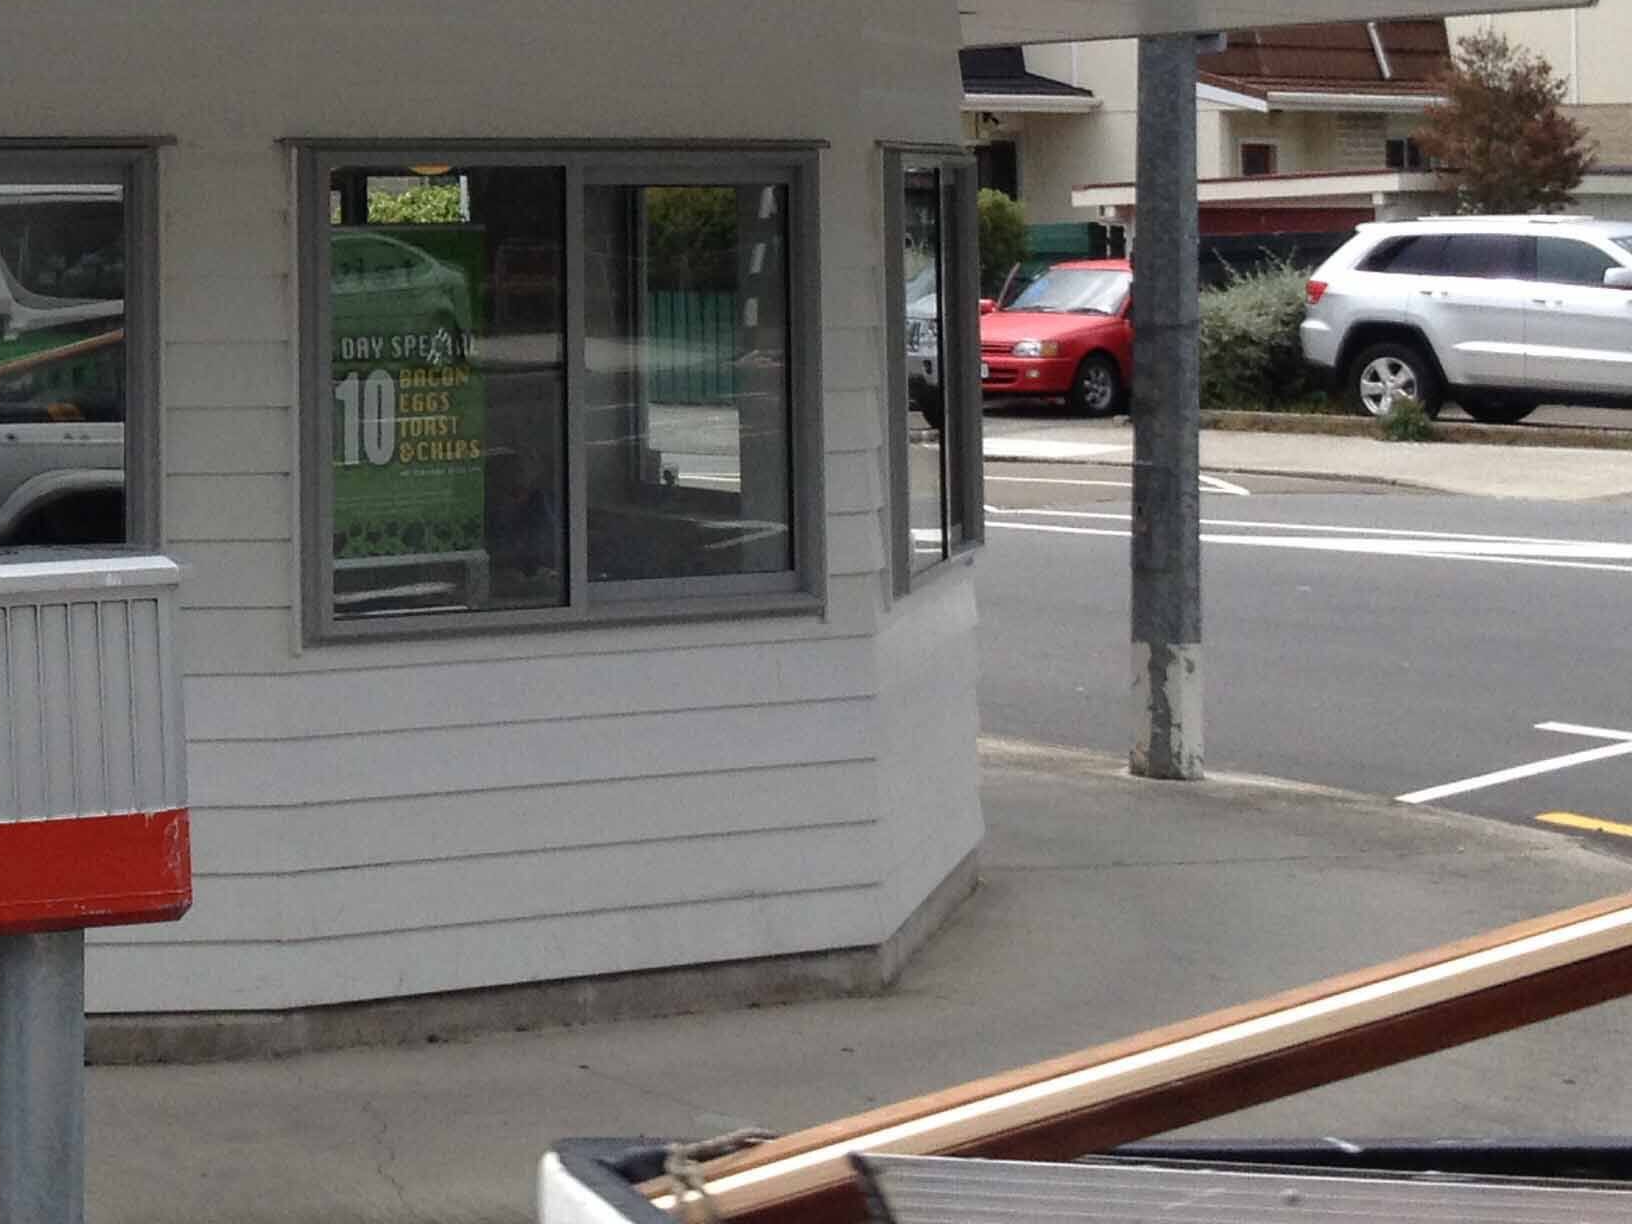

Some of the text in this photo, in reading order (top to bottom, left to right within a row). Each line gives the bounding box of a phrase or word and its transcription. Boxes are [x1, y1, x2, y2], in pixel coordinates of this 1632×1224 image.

[340, 335, 384, 361] DAY
[399, 365, 470, 389] BACON
[399, 391, 451, 413] EGGS
[334, 368, 396, 466] 10
[399, 415, 458, 438] TOAST
